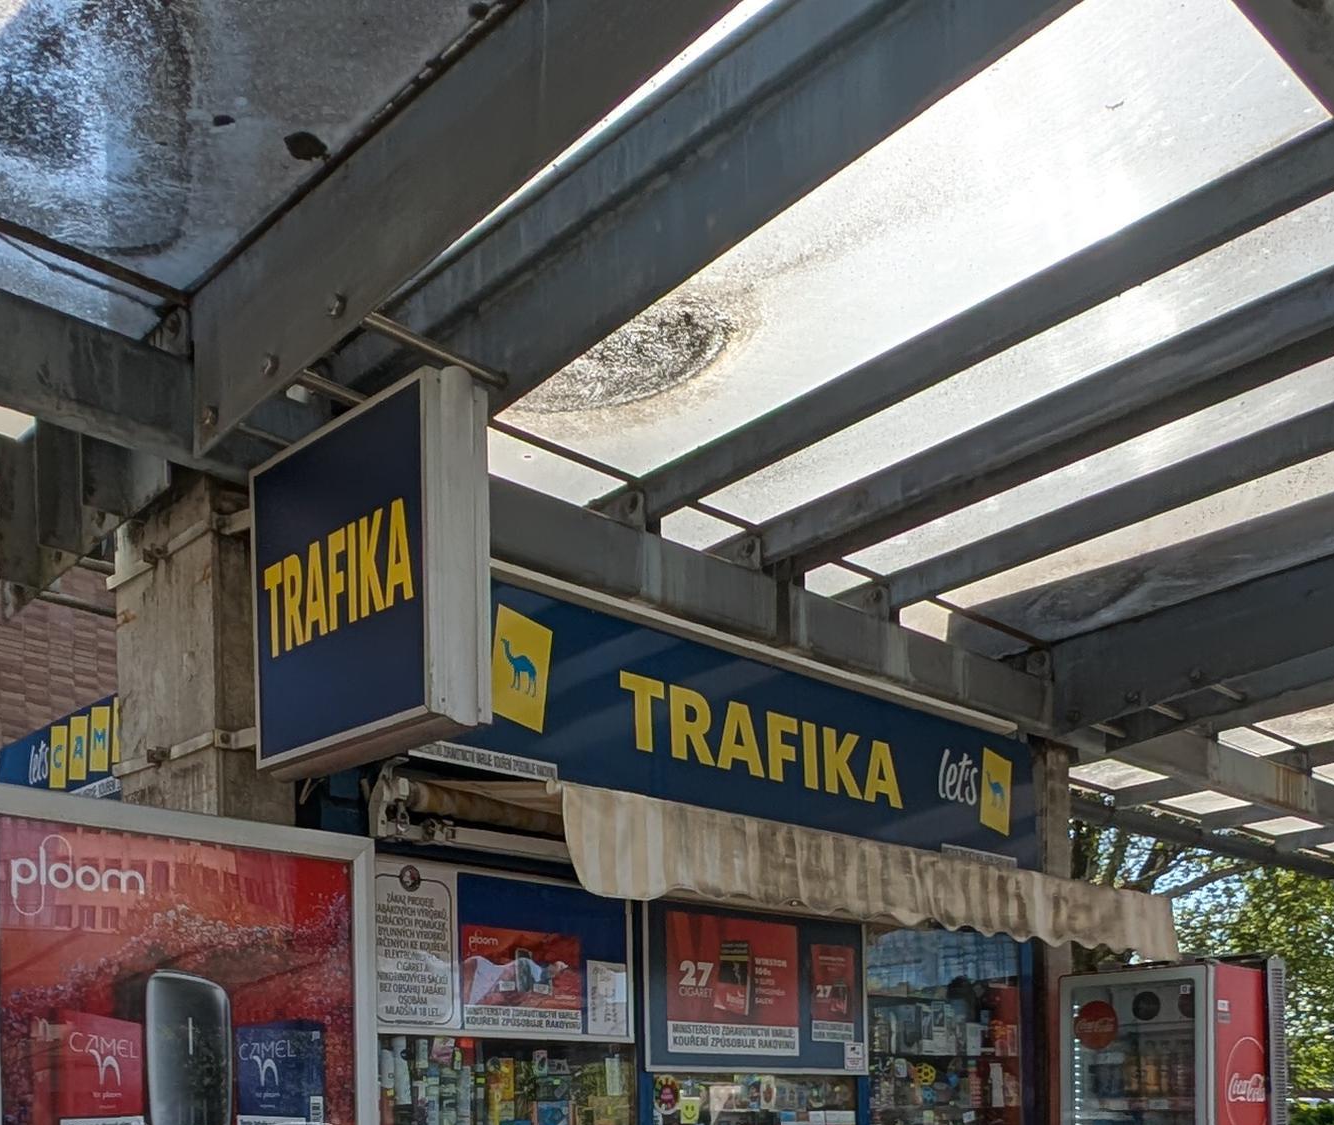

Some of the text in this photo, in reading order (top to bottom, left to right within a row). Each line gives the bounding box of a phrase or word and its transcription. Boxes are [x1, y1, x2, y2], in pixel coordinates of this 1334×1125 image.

[264, 496, 414, 660] TRAFIKA
[619, 670, 904, 811] TRAFIKA
[938, 748, 979, 806] let's
[11, 834, 145, 917] ploom
[469, 929, 499, 952] ploom
[679, 960, 714, 987] 27
[379, 983, 392, 993] BEZ
[678, 985, 714, 998] CIGARET
[816, 984, 833, 998] 27
[419, 1007, 427, 1016] 18
[672, 1023, 721, 1036] MINISTERSTVO
[69, 1031, 139, 1059] CAMEL
[238, 1039, 297, 1061] CAMEL
[672, 1034, 796, 1051] KOUŘENÍ ZPŮSOBUJE RAKOVINU
